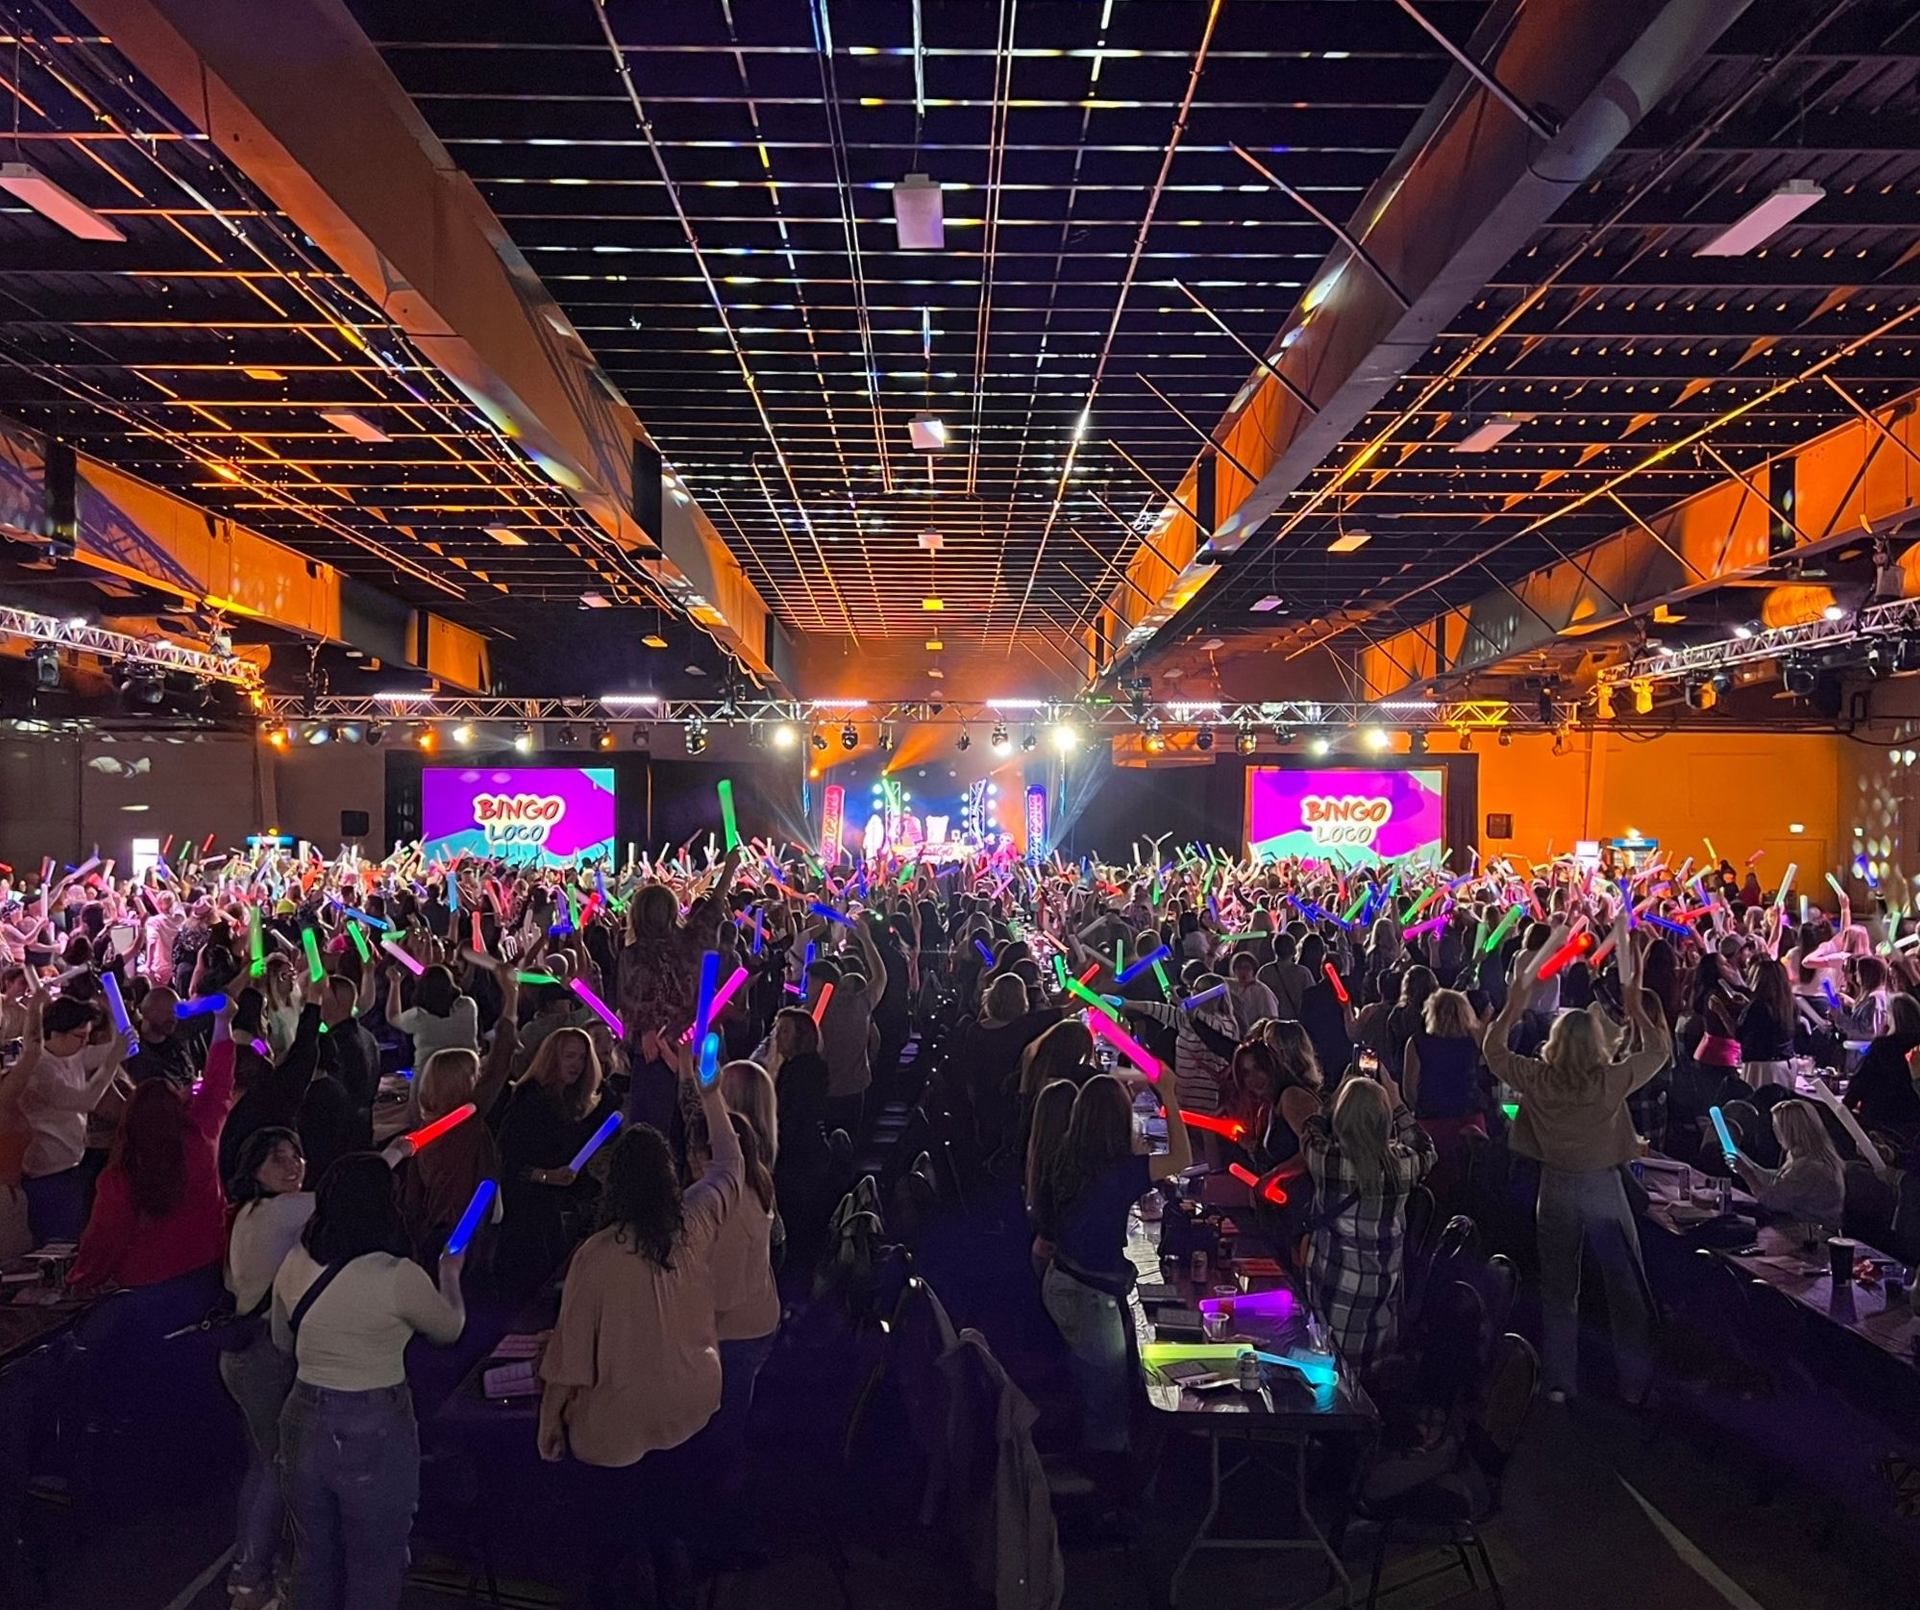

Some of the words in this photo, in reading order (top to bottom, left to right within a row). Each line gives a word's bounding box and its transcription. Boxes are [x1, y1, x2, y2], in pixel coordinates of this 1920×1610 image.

[477, 799, 560, 821] BINGO
[1305, 801, 1387, 822] BINGO
[490, 824, 544, 842] LOCO
[1317, 825, 1371, 842] LOCO
